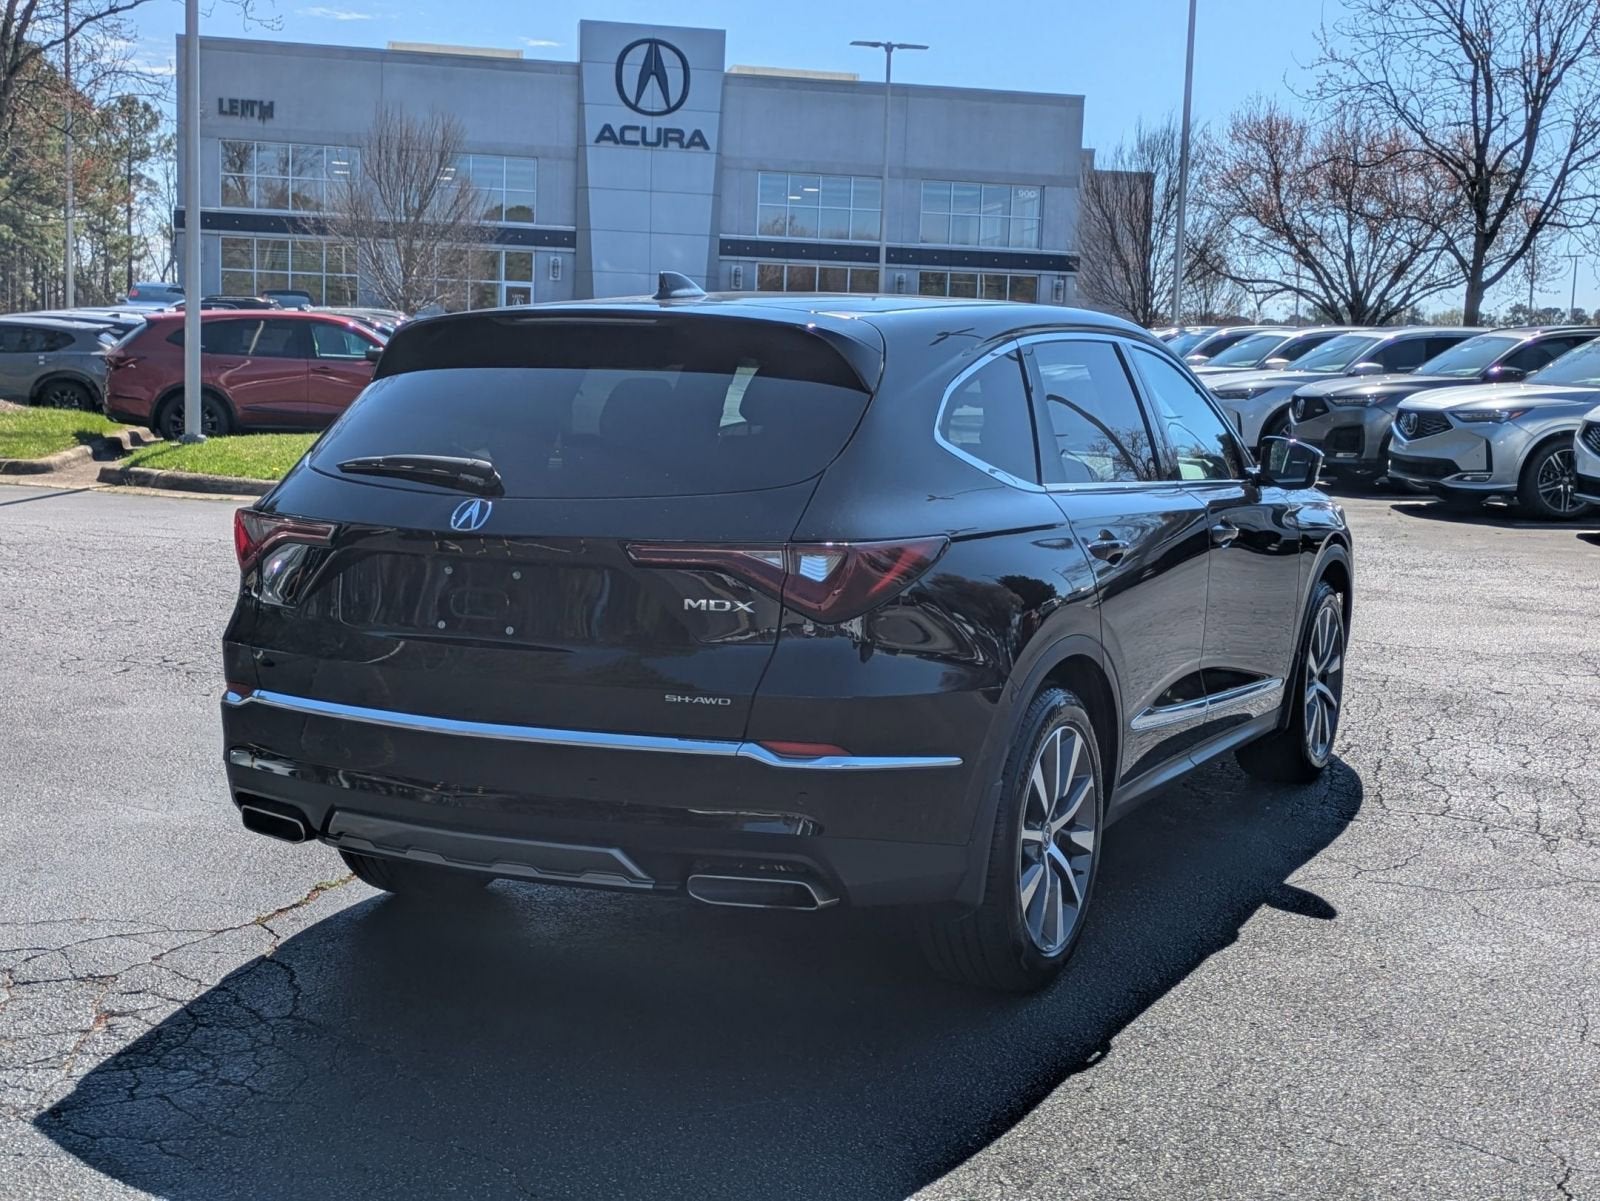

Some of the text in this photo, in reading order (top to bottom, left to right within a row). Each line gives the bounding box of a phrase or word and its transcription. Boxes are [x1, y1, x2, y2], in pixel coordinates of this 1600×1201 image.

[218, 98, 274, 120] LEITH
[594, 123, 710, 151] ACURA
[683, 598, 756, 614] MDX
[664, 694, 732, 706] SH-AWD
